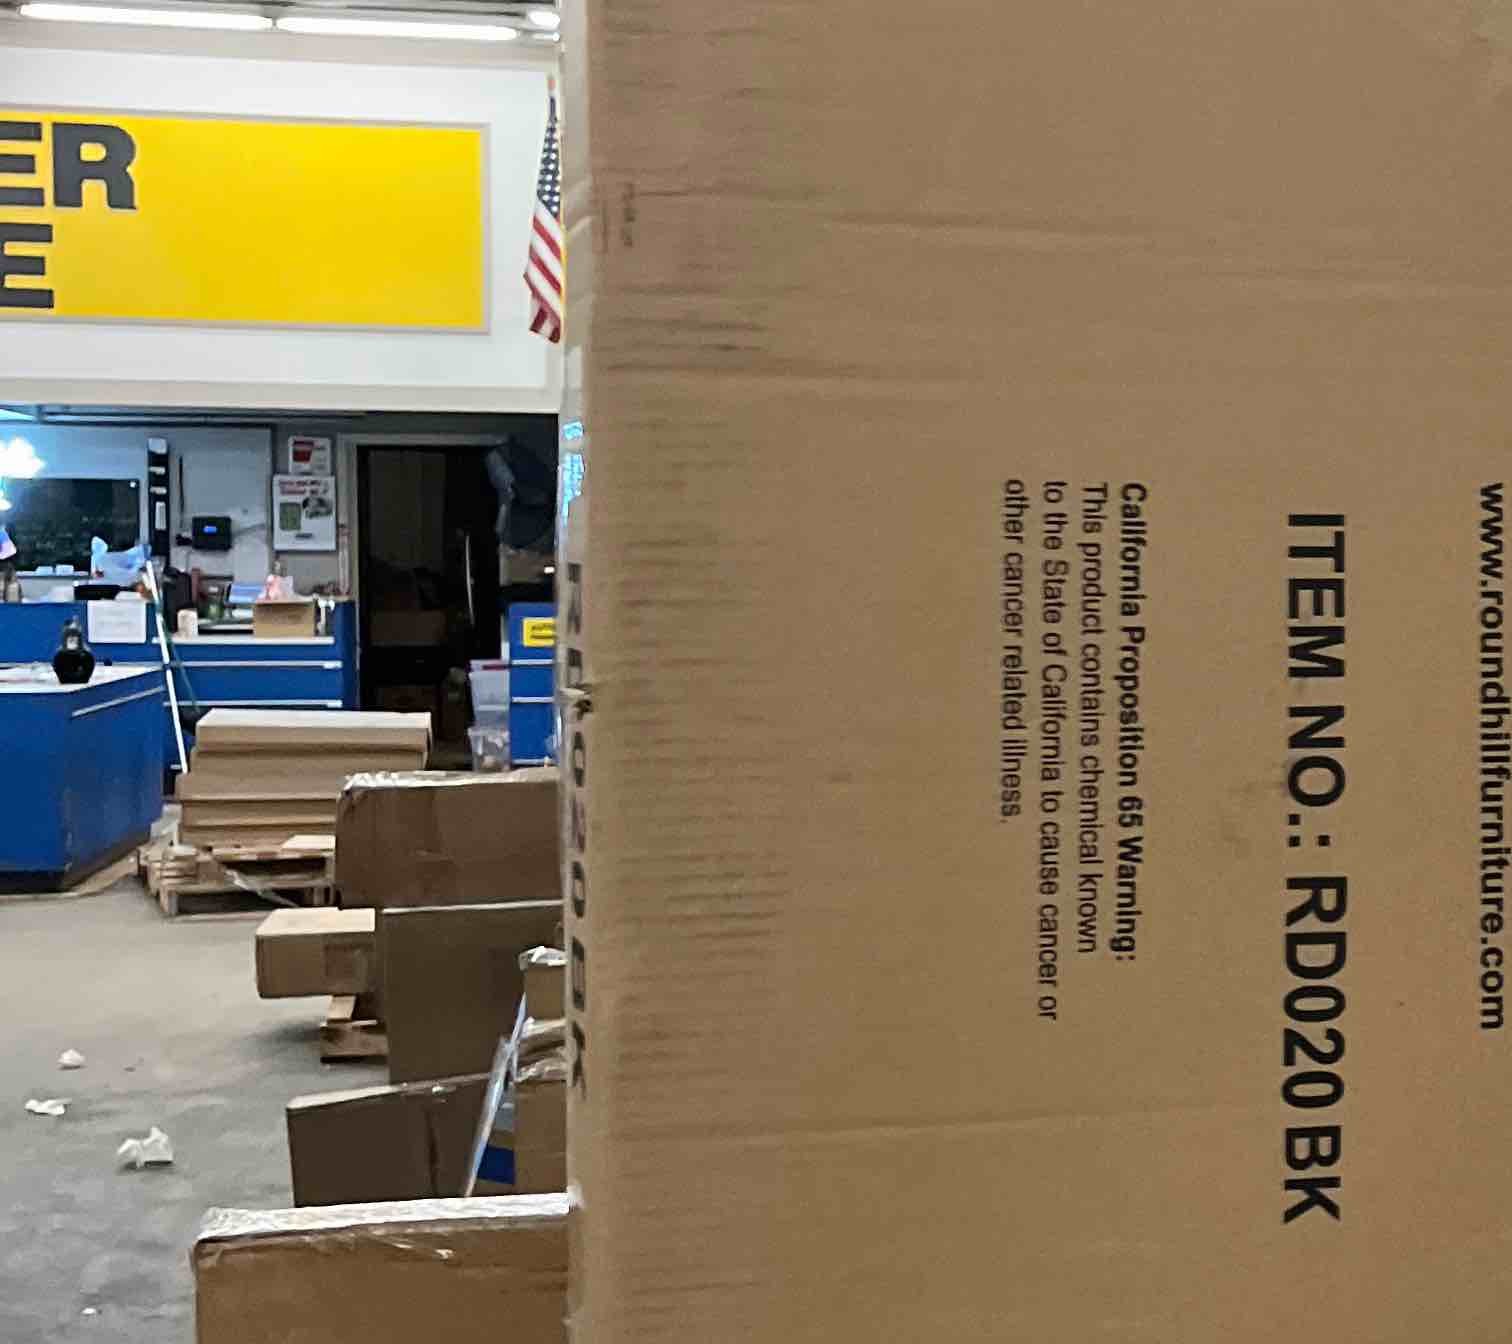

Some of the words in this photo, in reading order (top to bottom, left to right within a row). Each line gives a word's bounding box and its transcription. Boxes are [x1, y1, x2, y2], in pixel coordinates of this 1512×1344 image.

[1002, 479, 1031, 545] other
[1042, 480, 1069, 504] to
[1042, 512, 1070, 551] the
[1081, 481, 1109, 534] This
[1041, 559, 1070, 624] State
[1075, 542, 1108, 636] product
[1119, 482, 1149, 617] California
[999, 551, 1025, 638] cancer
[1286, 513, 1347, 680] ITEM
[999, 644, 1030, 731] related
[1041, 632, 1069, 657] of
[1039, 663, 1069, 782] California
[1079, 642, 1107, 748] contains
[1111, 625, 1147, 787] Proposition
[999, 738, 1029, 824] illness.
[1283, 704, 1347, 849] NO.:
[1478, 482, 1512, 1030] www.roundhillfurniture.com
[1039, 790, 1065, 814] to
[1077, 754, 1105, 865] chemical
[1117, 795, 1145, 829] 65
[1038, 821, 1061, 896] cause
[1108, 835, 1145, 961] Warning:
[1036, 903, 1060, 988] cancer
[1076, 873, 1104, 954] known
[1037, 995, 1057, 1021] or
